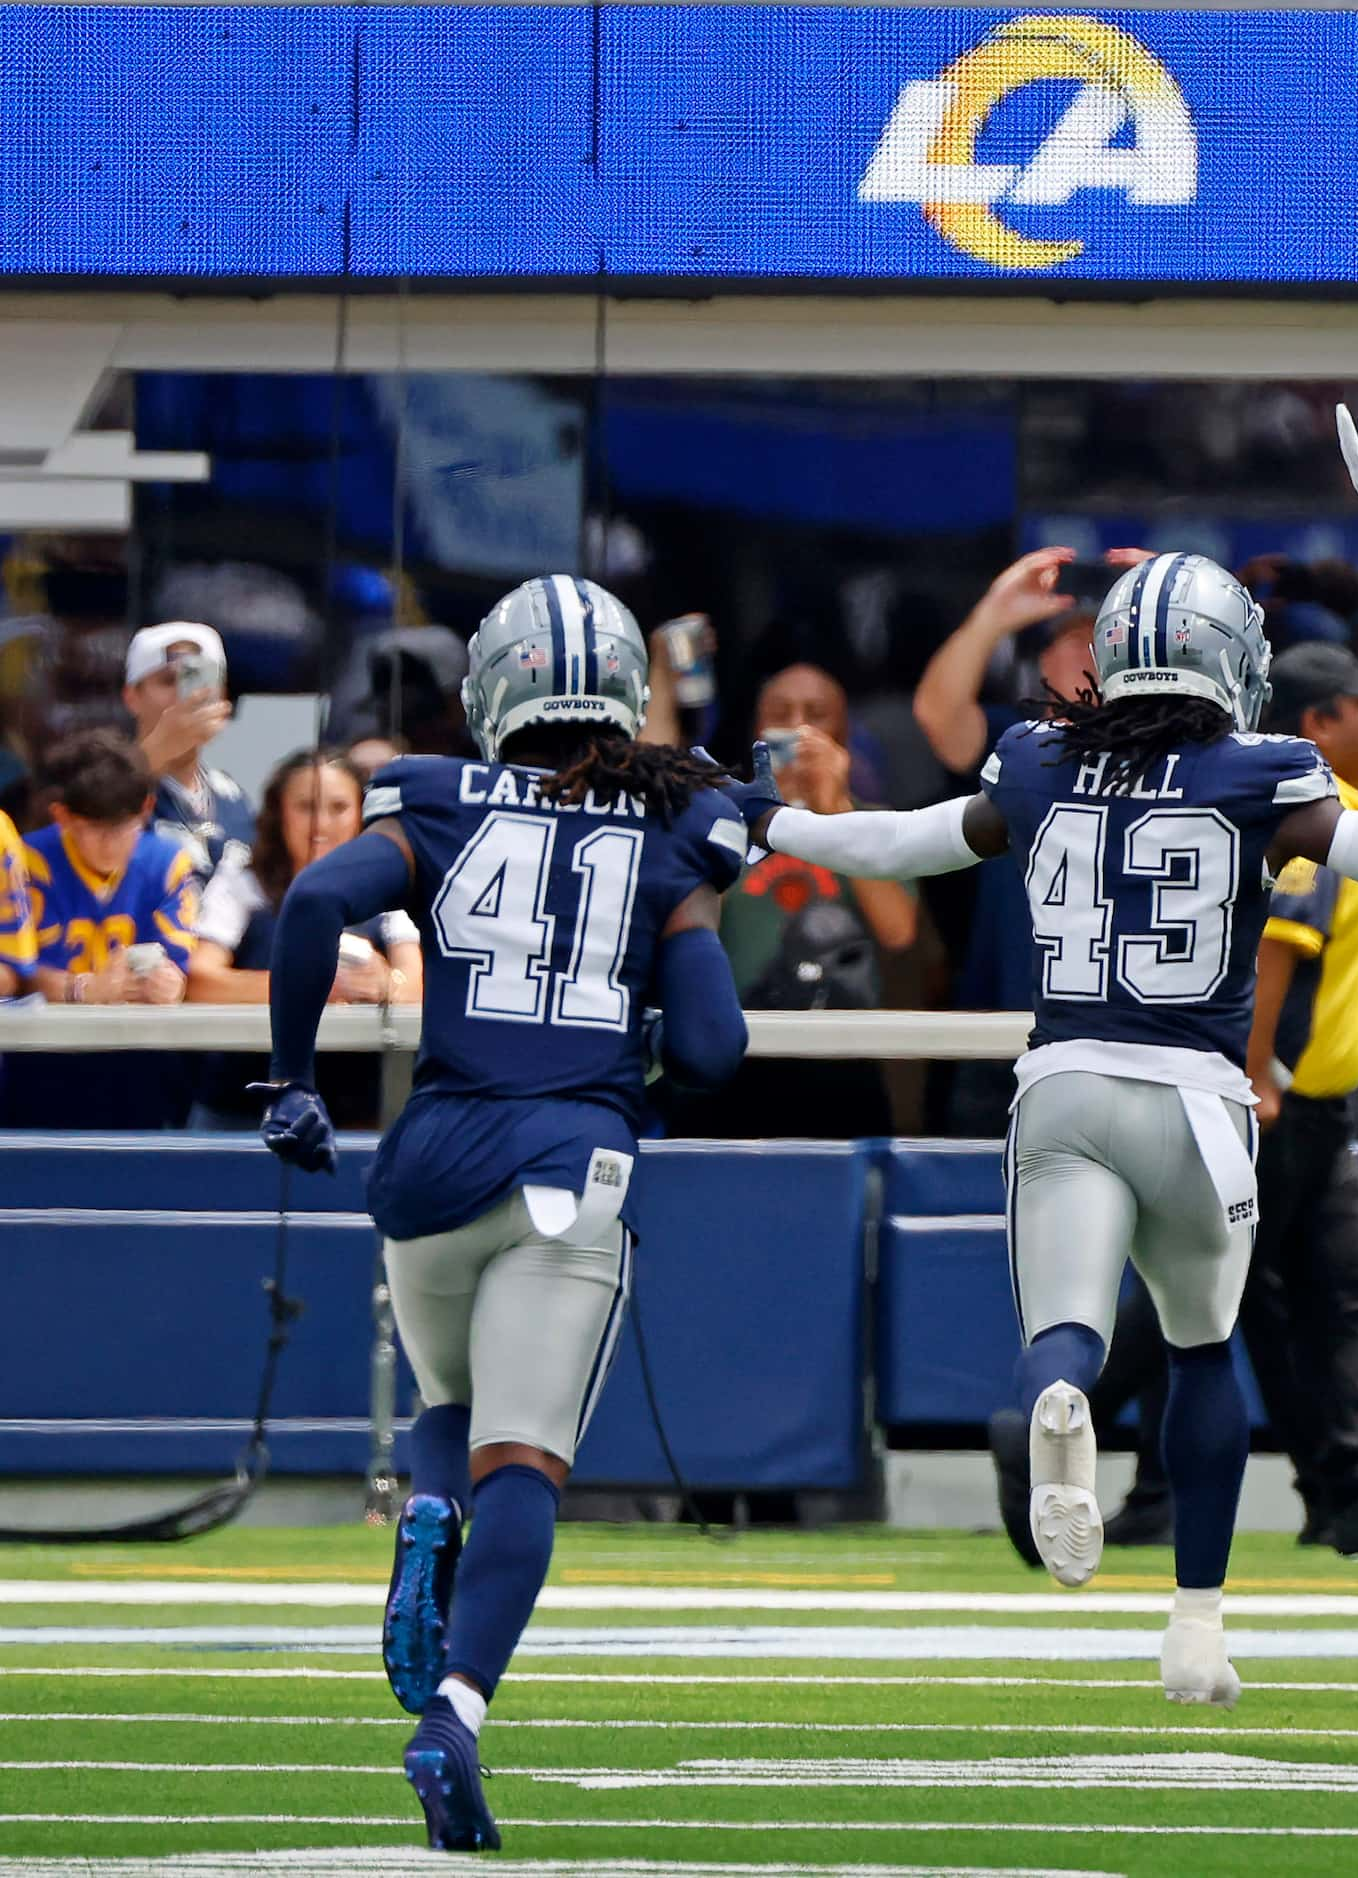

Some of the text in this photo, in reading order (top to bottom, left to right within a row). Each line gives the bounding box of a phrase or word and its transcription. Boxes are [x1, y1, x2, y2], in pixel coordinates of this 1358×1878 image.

[857, 78, 1198, 206] LA
[543, 699, 606, 711] COWBOYS
[1123, 671, 1179, 683] COWBOYS
[431, 809, 645, 1034] 41
[1024, 801, 1242, 1006] 43
